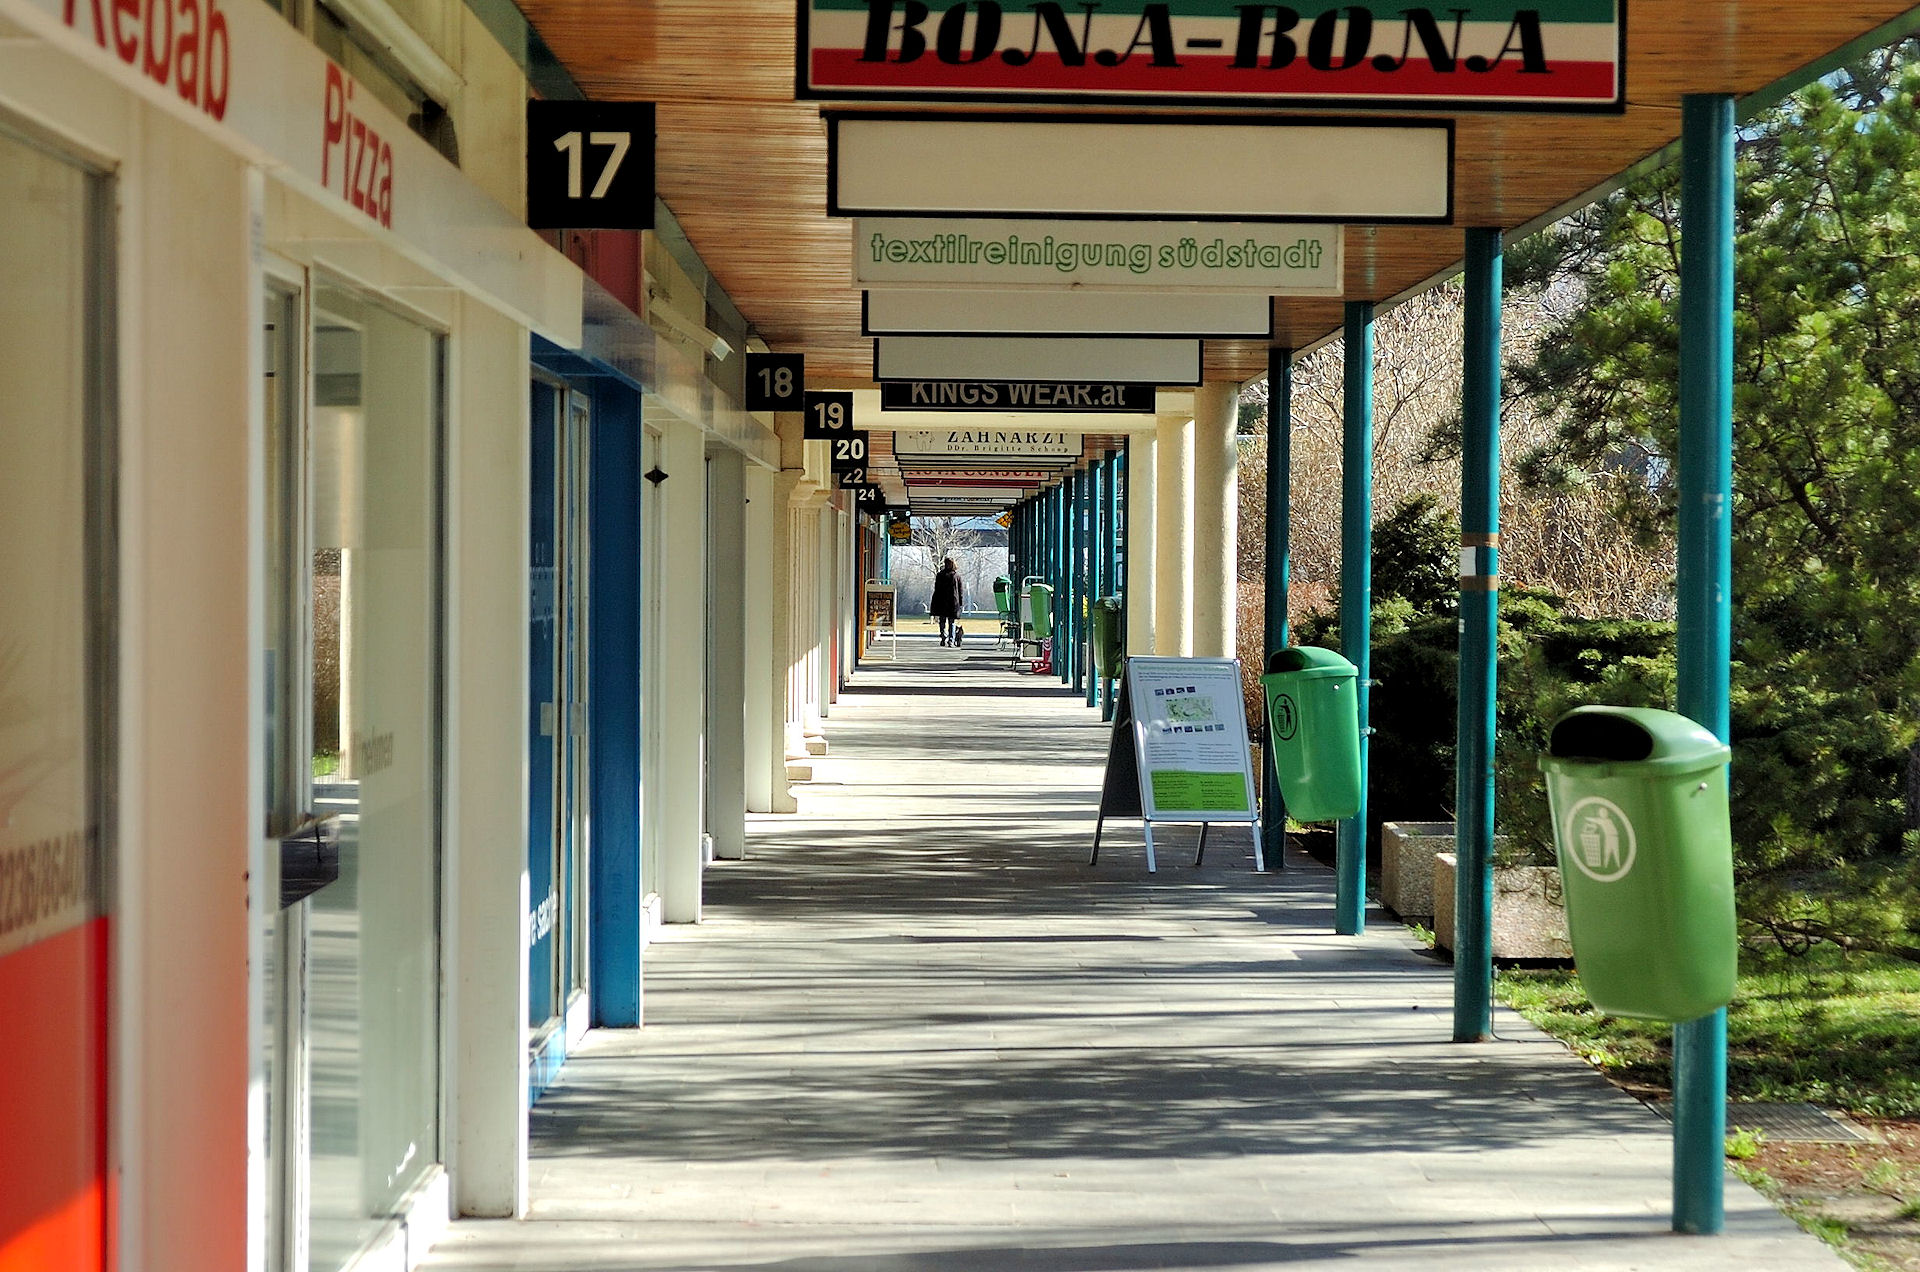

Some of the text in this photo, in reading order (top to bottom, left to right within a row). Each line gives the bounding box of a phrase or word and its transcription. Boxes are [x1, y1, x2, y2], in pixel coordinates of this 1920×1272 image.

[321, 60, 393, 231] Pizza
[552, 131, 631, 199] 17
[871, 233, 1323, 273] textilreinigung südstadt
[757, 366, 794, 398] 18
[911, 382, 1126, 406] KINGS WEAR.at
[813, 402, 845, 429] 19
[836, 439, 865, 460] 20
[946, 431, 1069, 444] ZAHNARZT
[842, 467, 863, 484] 22
[858, 488, 876, 501] 24
